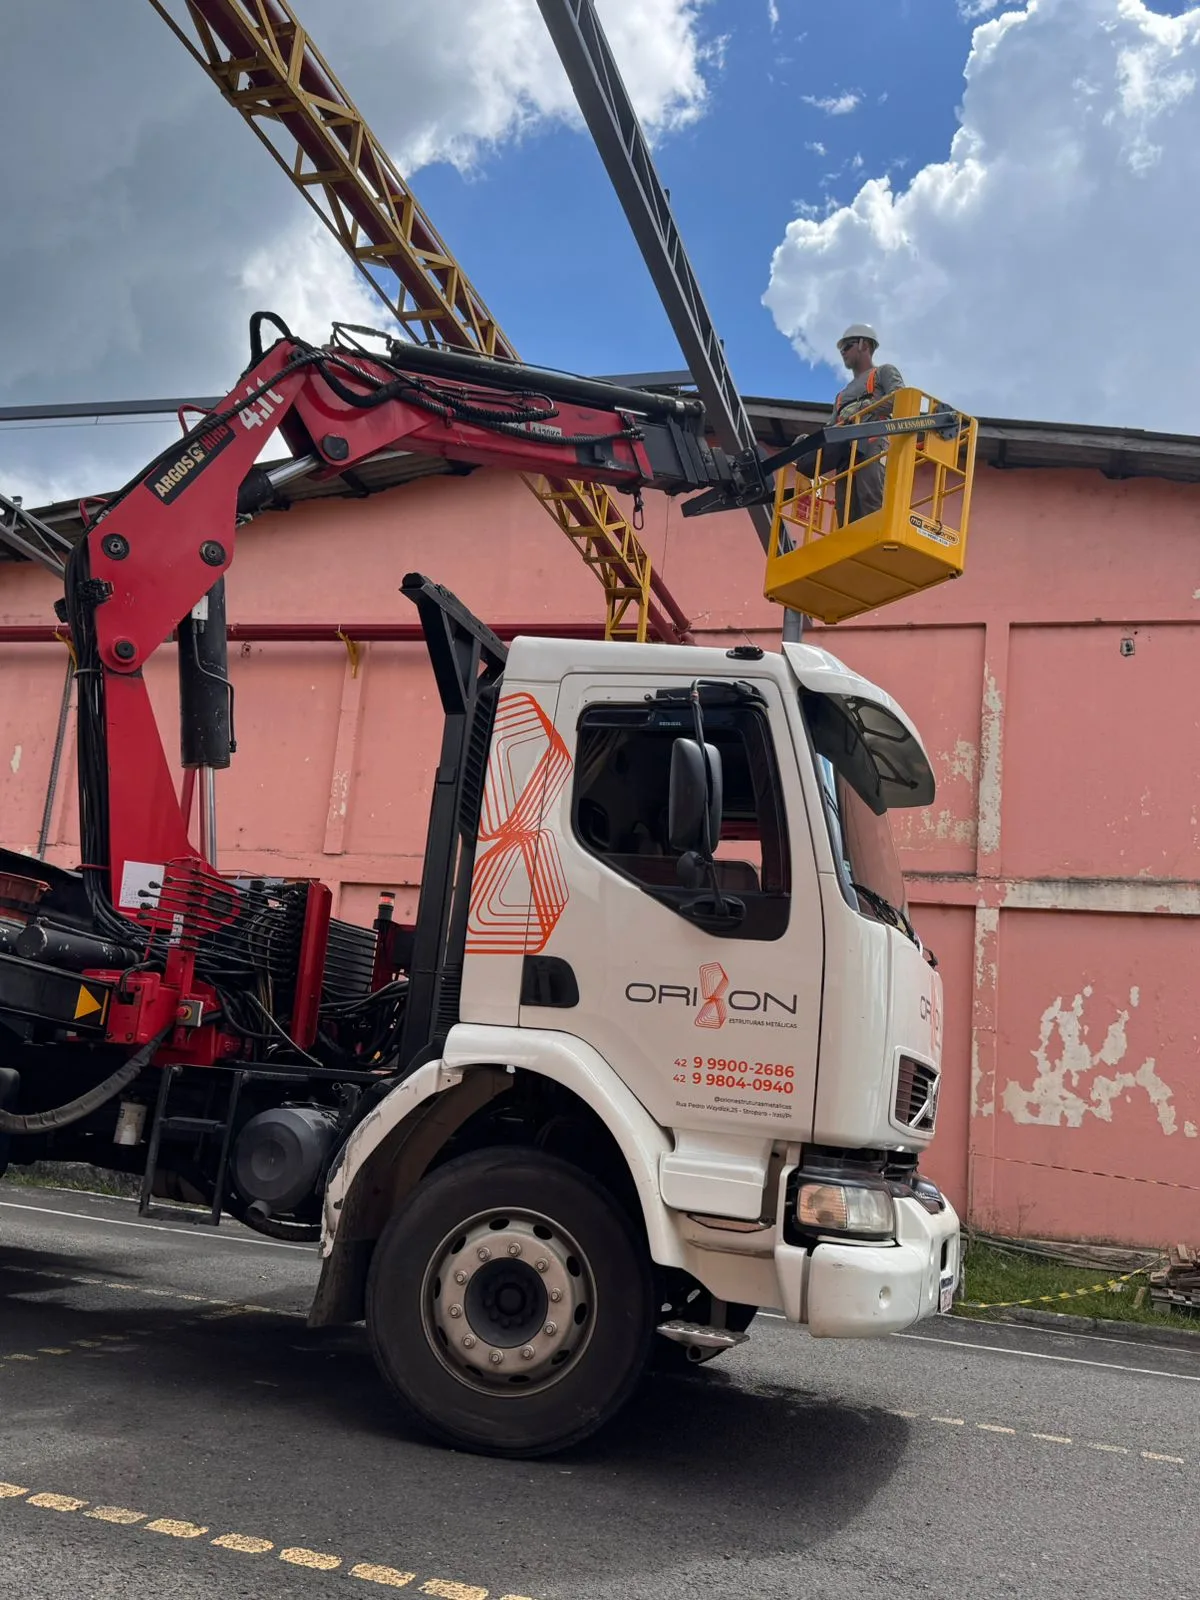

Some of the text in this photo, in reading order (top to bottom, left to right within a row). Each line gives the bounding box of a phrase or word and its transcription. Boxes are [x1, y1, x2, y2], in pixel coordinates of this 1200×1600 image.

[154, 455, 195, 497] ARGOS
[625, 983, 797, 1014] ORION
[729, 1018, 797, 1028] ESTRUTURAS METÁLICAS
[674, 1056, 795, 1078] 42 9 9900-2686
[673, 1072, 794, 1094] 42 9 9804-0940
